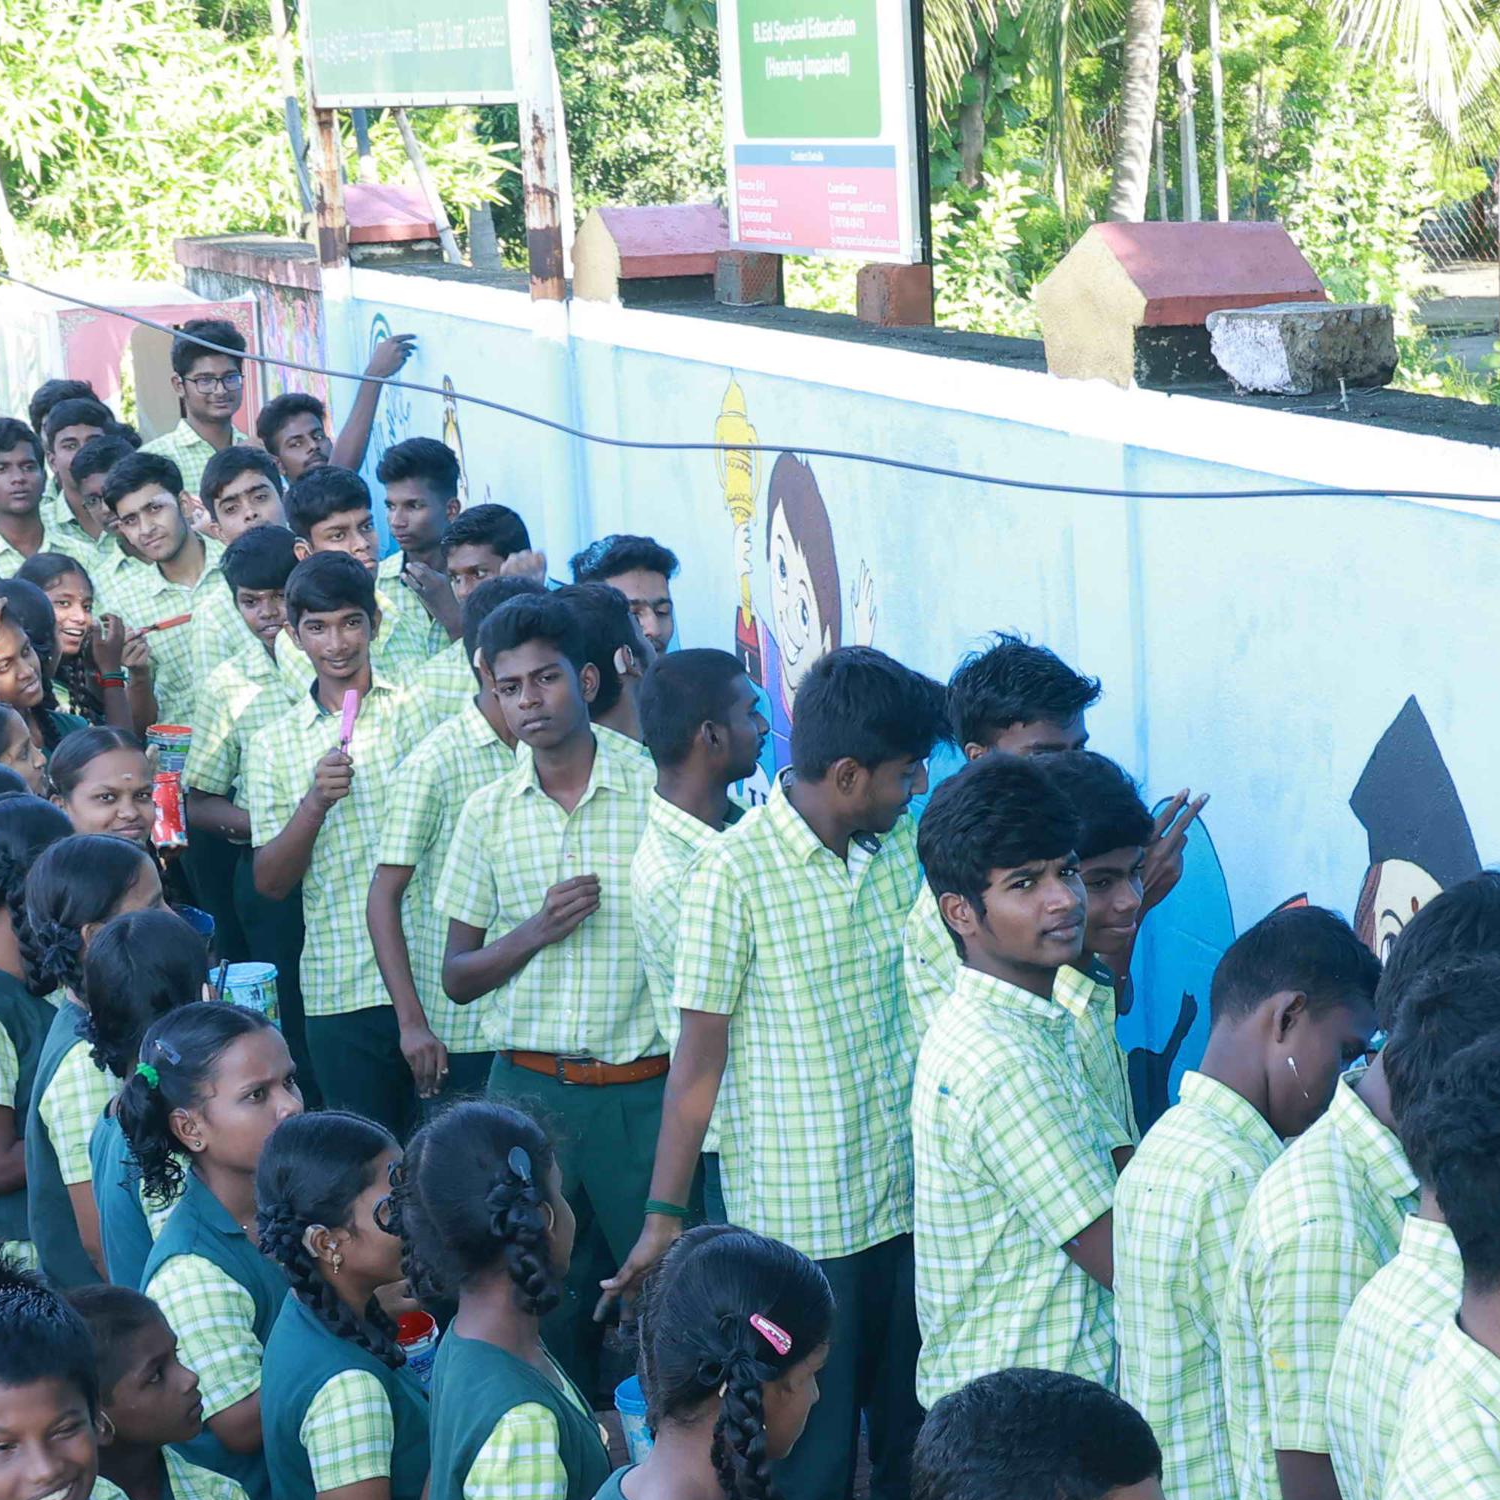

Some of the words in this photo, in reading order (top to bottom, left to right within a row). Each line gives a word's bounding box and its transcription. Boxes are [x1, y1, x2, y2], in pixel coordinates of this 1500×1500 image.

[753, 20, 773, 43] B.Ed
[774, 17, 807, 46] Special
[807, 13, 857, 40] Education
[766, 54, 803, 81] (Hearing
[804, 51, 851, 80] Impaired)
